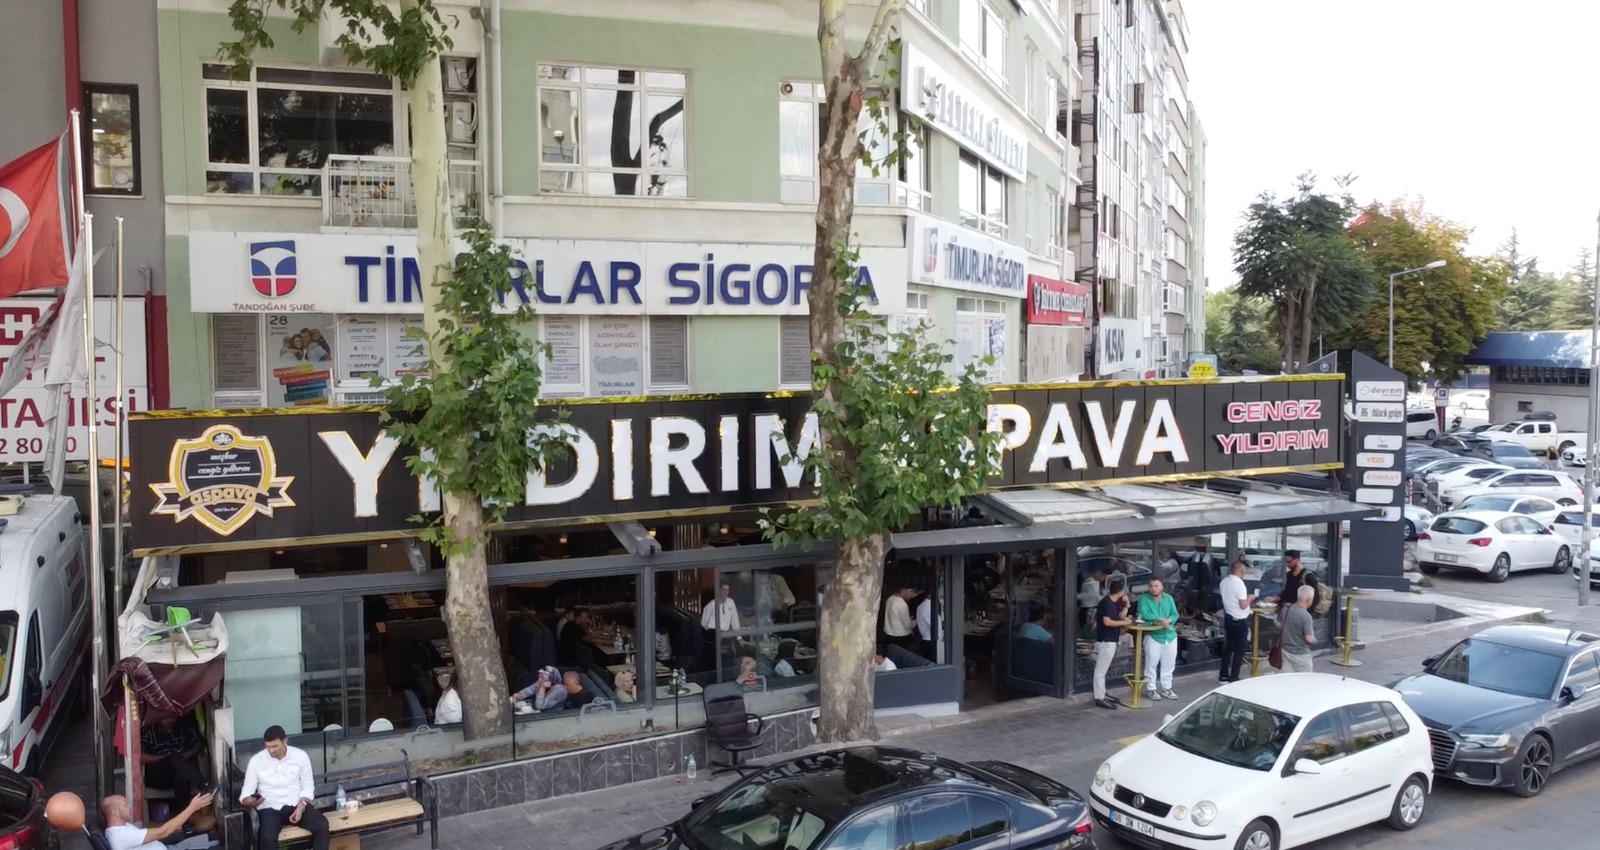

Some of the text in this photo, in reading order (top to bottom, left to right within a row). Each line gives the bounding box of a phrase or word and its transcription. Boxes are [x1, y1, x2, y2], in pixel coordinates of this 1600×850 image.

[233, 302, 287, 311] TANDOĞAN
[270, 315, 288, 325] 28
[1370, 386, 1403, 394] devrem
[1227, 400, 1321, 423] CENGİZ
[1218, 429, 1328, 455] YILDIRIM
[190, 488, 257, 505] aspava
